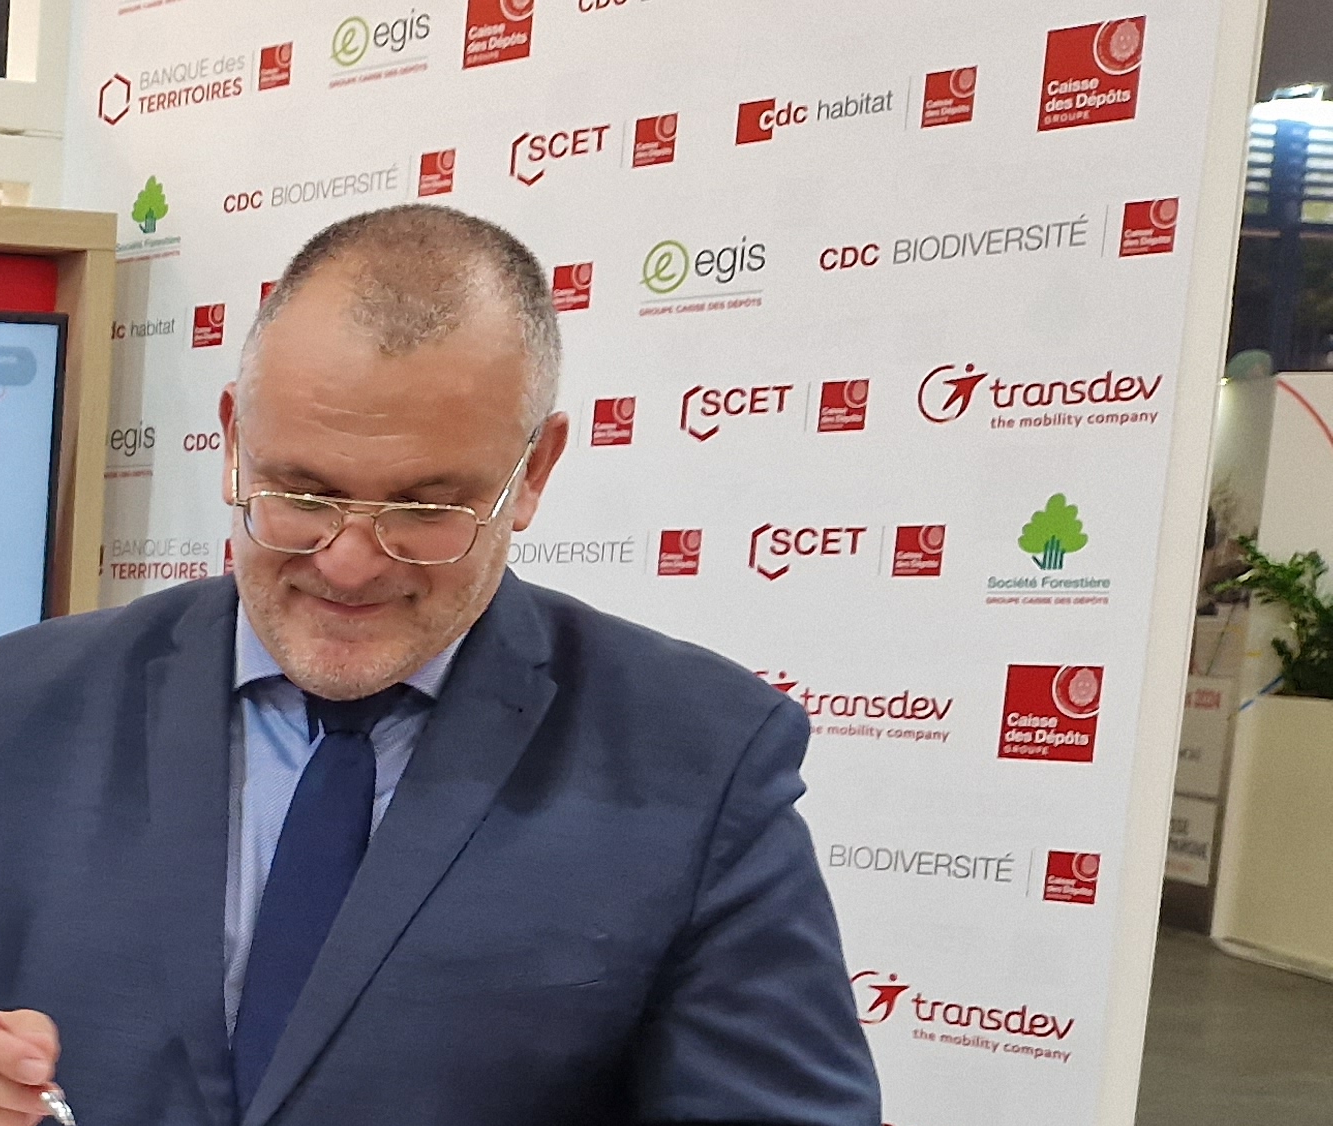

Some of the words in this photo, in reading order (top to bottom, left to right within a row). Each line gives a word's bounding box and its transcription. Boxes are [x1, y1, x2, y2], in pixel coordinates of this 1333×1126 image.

[373, 9, 431, 52] egis
[139, 58, 209, 91] BANQUE
[213, 55, 245, 75] des
[1047, 78, 1099, 96] Caisse
[138, 77, 243, 114] TERRITOIRES
[758, 101, 808, 131] cdc
[817, 90, 893, 121] habitat
[1045, 97, 1073, 112] des
[1075, 88, 1131, 110] Dépôts
[1044, 110, 1090, 125] GROUPE
[528, 124, 611, 162] SCET
[223, 190, 263, 213] CDC
[271, 164, 400, 207] BIODIVERSITÉ
[819, 243, 880, 271] CDC
[892, 213, 1089, 265] BIODIVERSITÉ
[694, 236, 766, 283] egis
[130, 318, 175, 337] habitat
[700, 384, 794, 417] SCET
[989, 370, 1163, 408] transdev
[990, 415, 1015, 429] the
[1019, 412, 1081, 430] mobility
[1086, 410, 1158, 427] company
[110, 421, 155, 457] egis
[183, 432, 221, 451] CDC
[111, 539, 177, 557] BANQUE
[180, 539, 210, 557] des
[507, 536, 634, 564] ODIVERSITÉ
[770, 526, 868, 556] SCET
[110, 561, 208, 580] TERRITOIRES
[987, 575, 1037, 589] Société
[1041, 576, 1110, 589] Forestière
[800, 688, 954, 721] transdev
[1006, 712, 1058, 728] Caisse
[827, 723, 882, 739] mobility
[887, 728, 949, 743] company
[1004, 729, 1032, 743] des
[1034, 728, 1089, 747] Dépôts
[829, 844, 1015, 882] BIODIVERSITÉ
[911, 993, 1075, 1040] transdev
[912, 1028, 936, 1042] the
[940, 1033, 1000, 1053] mobility
[1003, 1042, 1072, 1063] company
